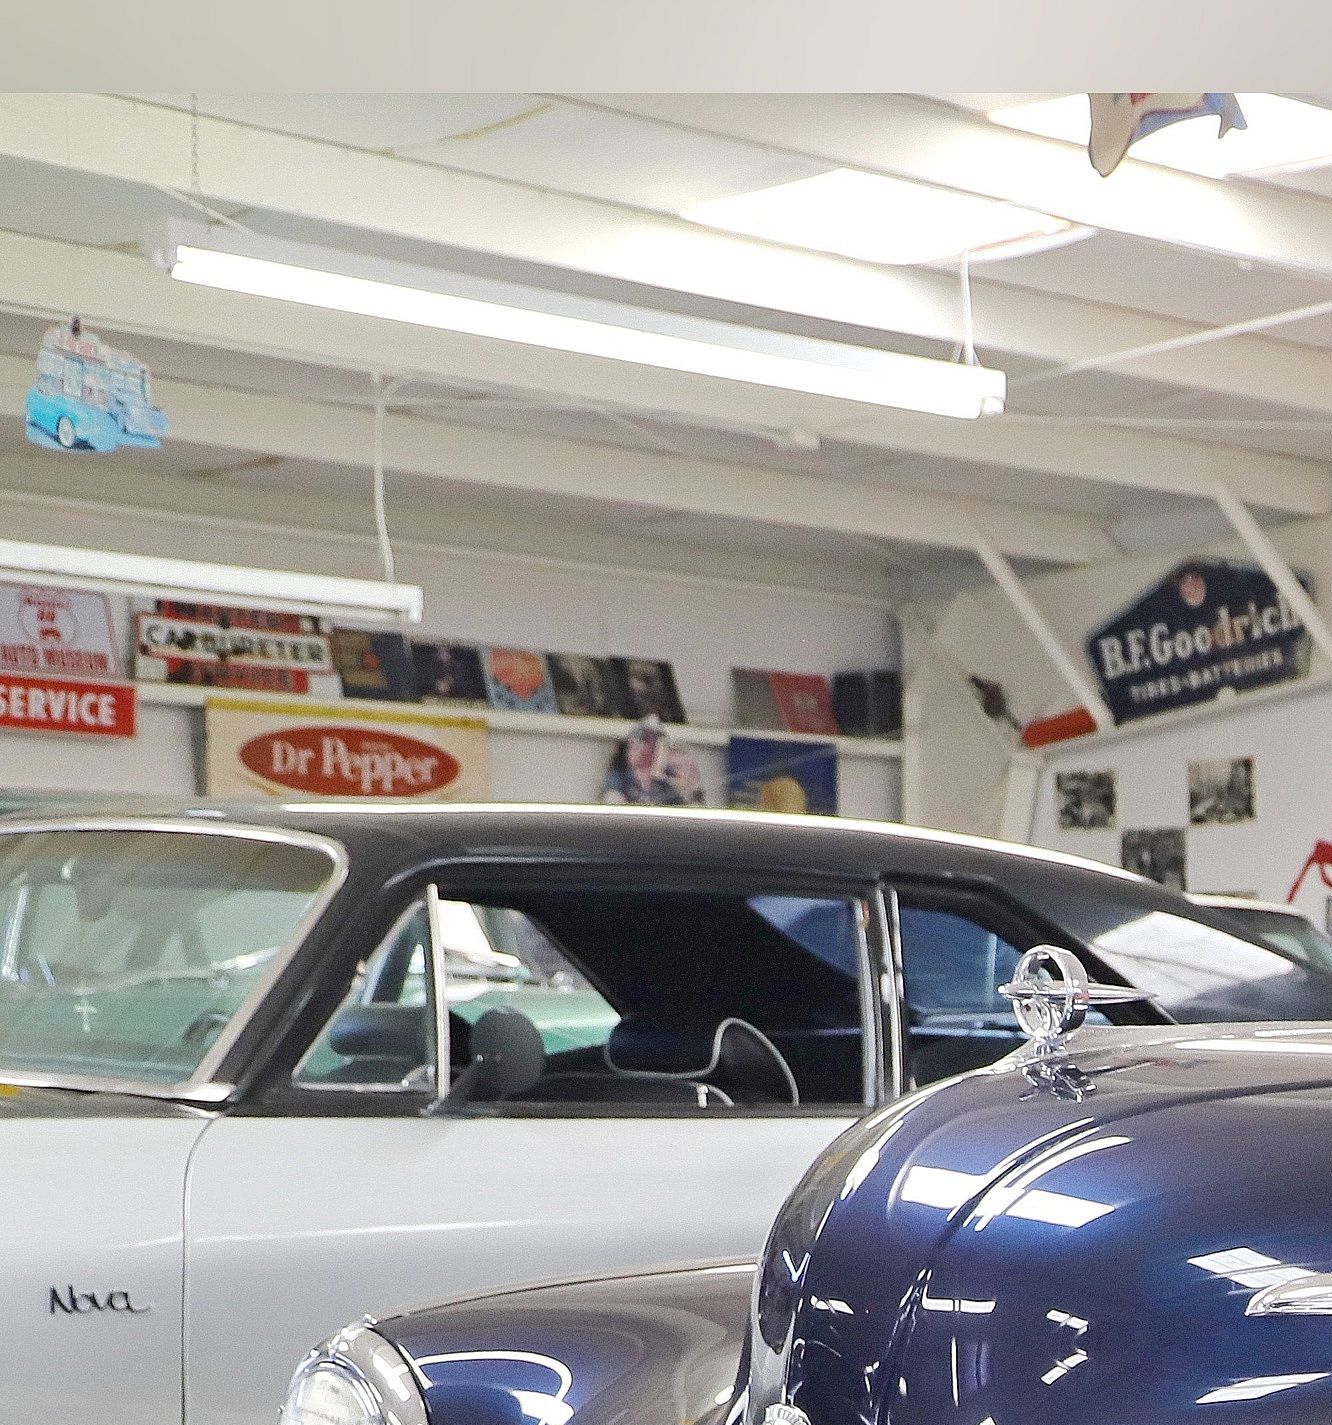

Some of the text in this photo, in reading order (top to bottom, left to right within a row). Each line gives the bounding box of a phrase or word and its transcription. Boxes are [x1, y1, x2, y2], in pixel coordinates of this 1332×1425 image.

[271, 736, 438, 794] Dr Pepper
[49, 1283, 152, 1315] Nova
